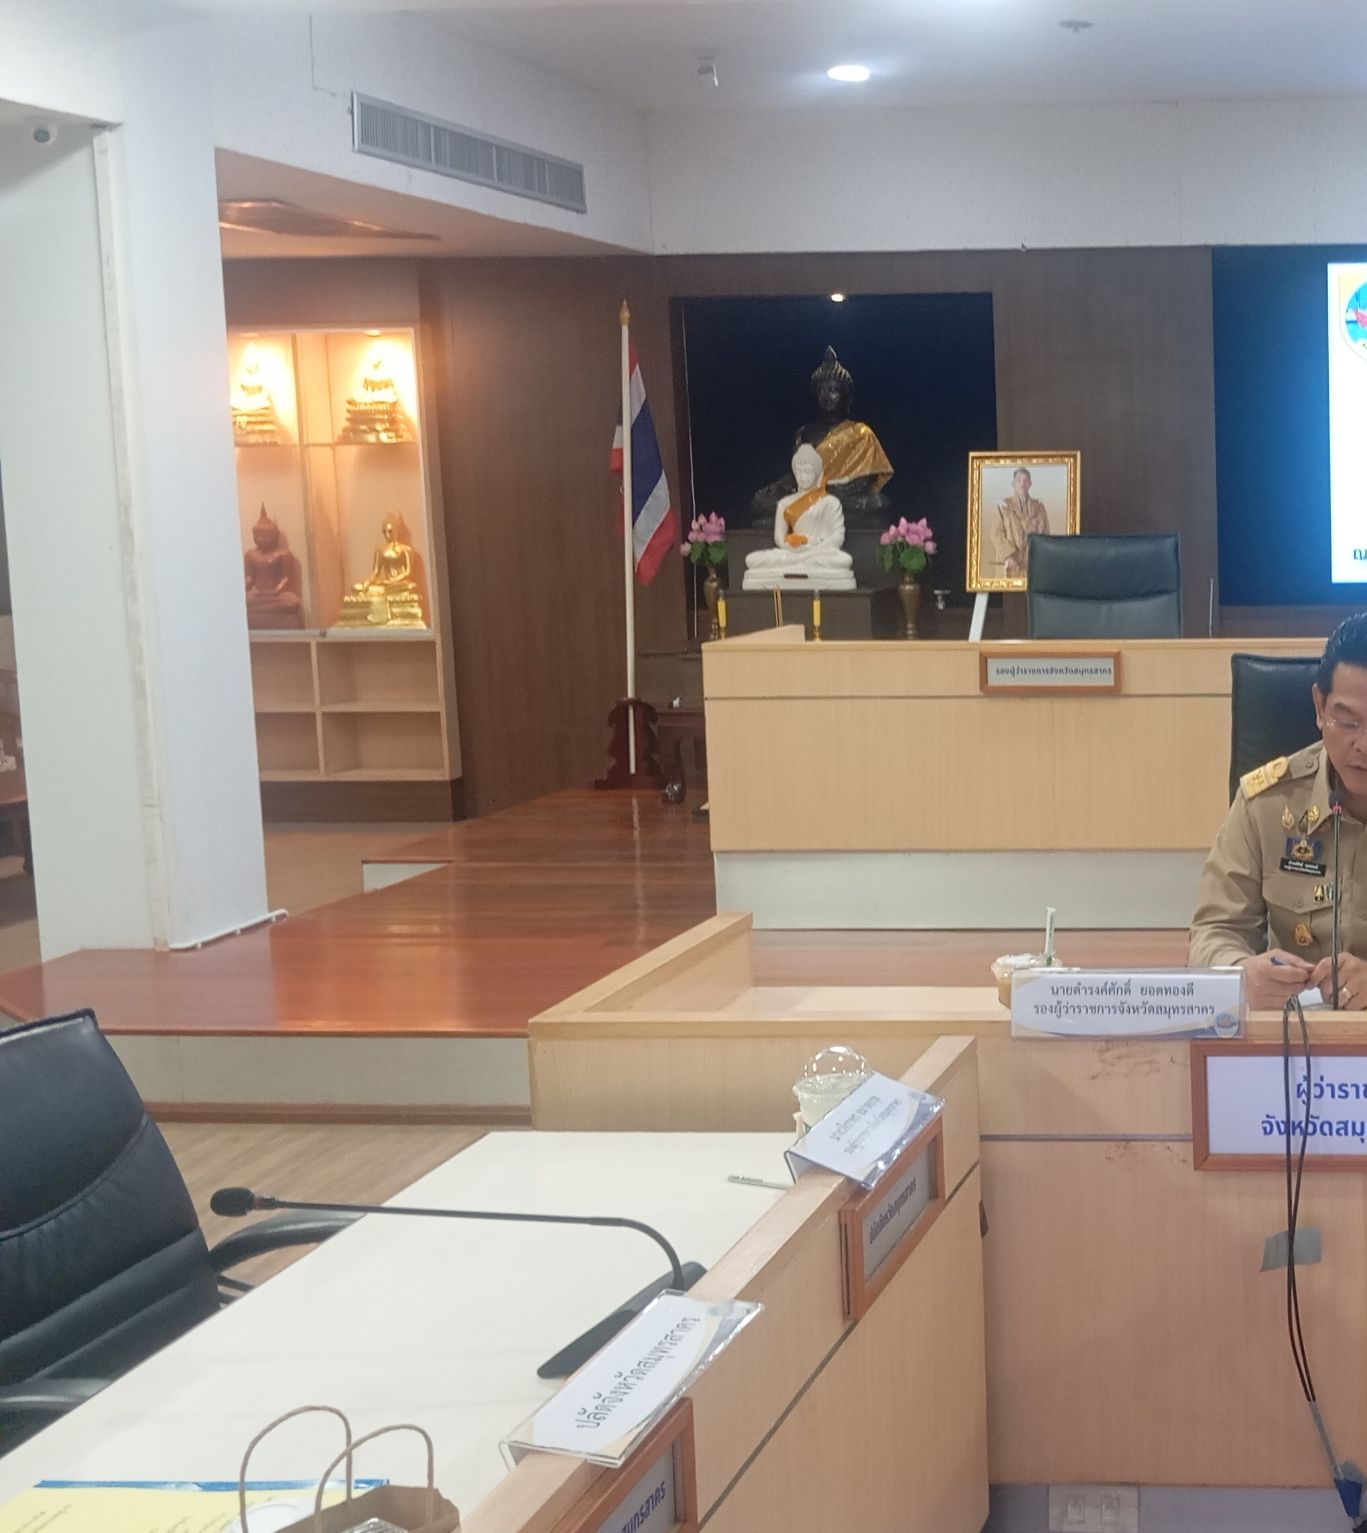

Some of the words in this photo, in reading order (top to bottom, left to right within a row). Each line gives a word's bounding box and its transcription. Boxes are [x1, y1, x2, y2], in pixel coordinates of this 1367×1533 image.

[1353, 548, 1367, 560] ณ
[1140, 982, 1194, 996] ยอดทองดี
[1034, 1000, 1215, 1020] รองผู้ว่าราชการจังหวัดสมุทรสาคร
[576, 1316, 701, 1429] ปลัดจังหวัดสมุทรสาคร
